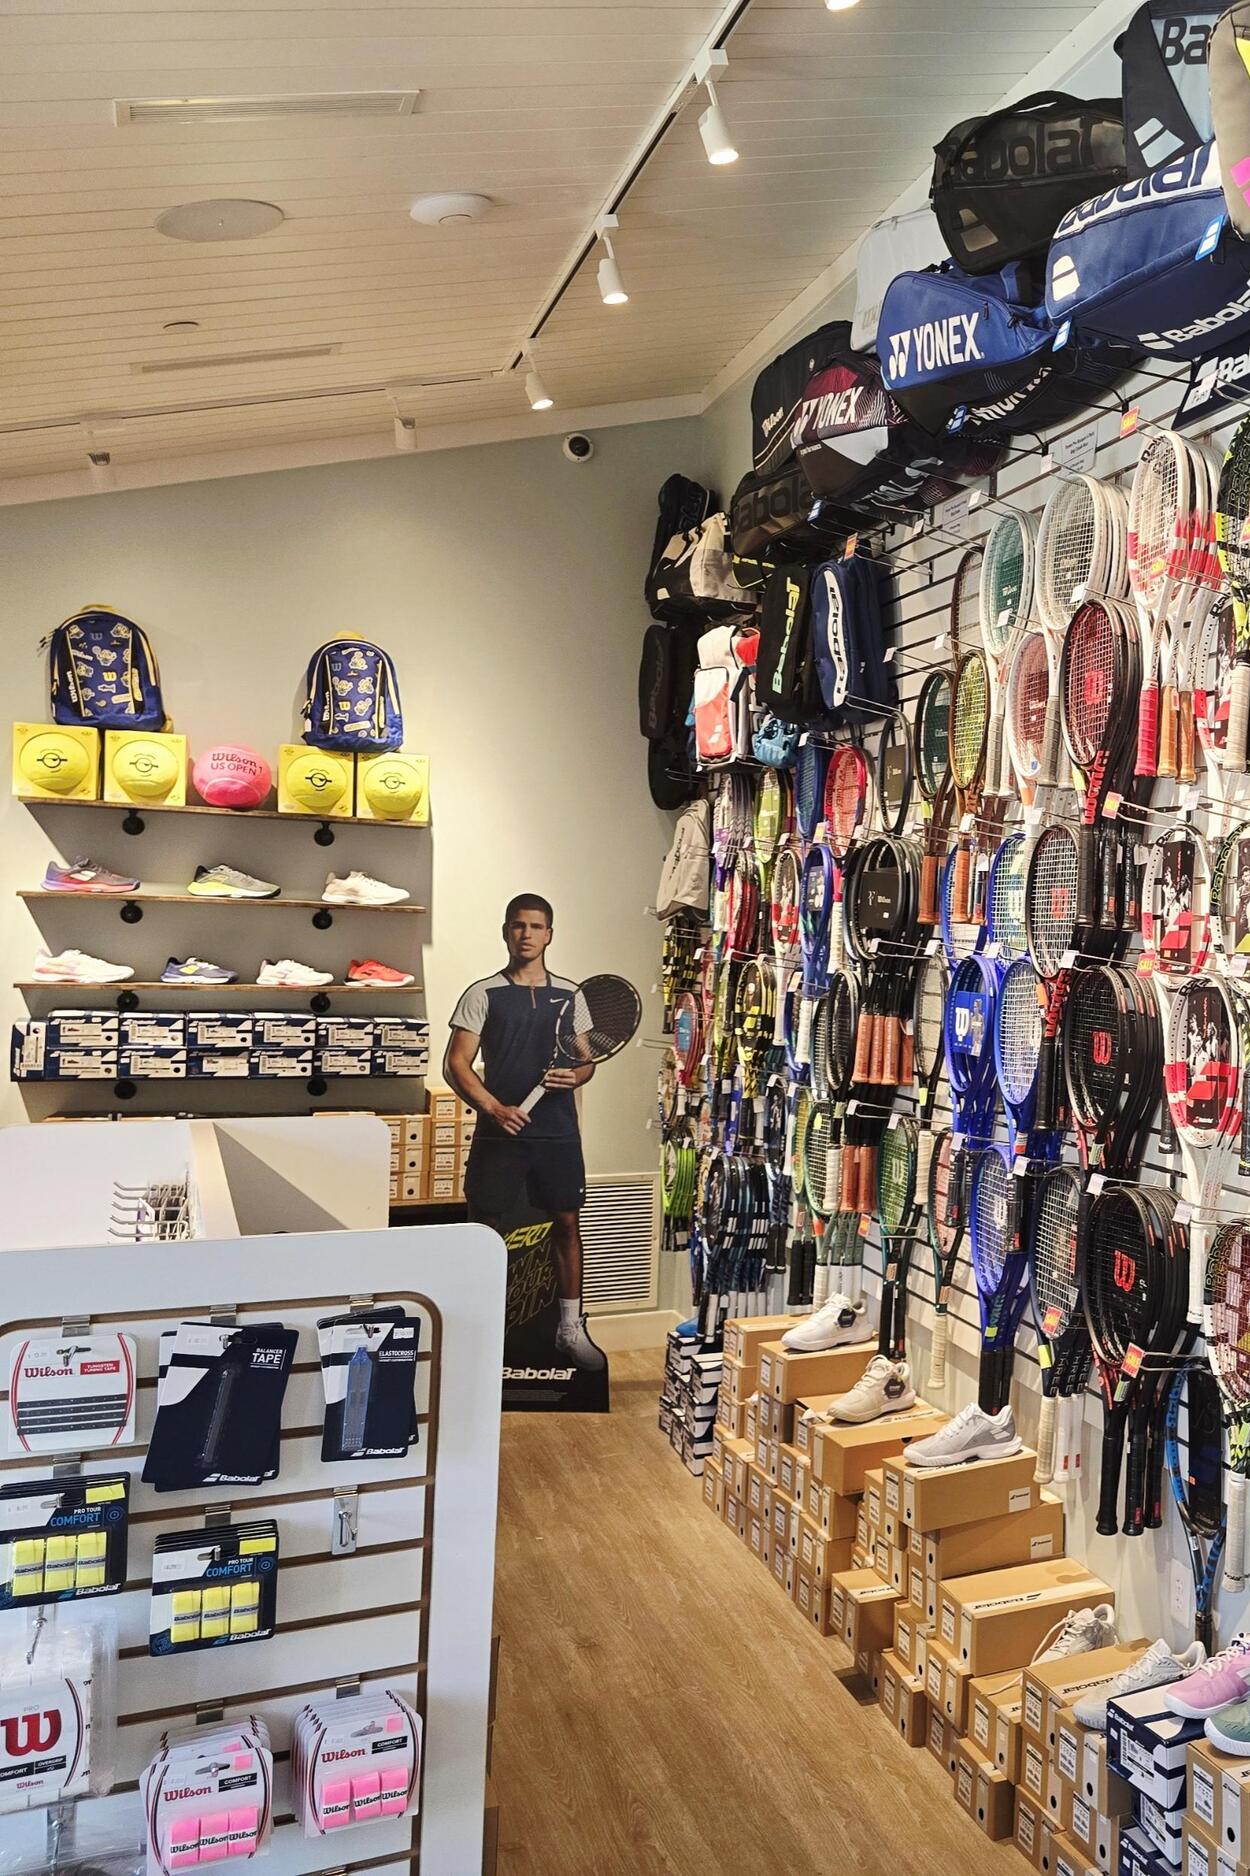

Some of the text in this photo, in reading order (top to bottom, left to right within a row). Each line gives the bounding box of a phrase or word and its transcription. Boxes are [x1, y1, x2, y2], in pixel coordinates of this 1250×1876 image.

[912, 312, 981, 372] YONEX
[813, 386, 863, 431] YONEX
[212, 753, 258, 769] Wilson
[211, 762, 257, 776] US OPEN
[252, 1353, 282, 1365] TAPE
[256, 1348, 283, 1356] BALANCER
[378, 1350, 414, 1358] ELASTOCROSS
[24, 1366, 74, 1378] Wilson
[51, 1512, 101, 1527] COMFORT
[206, 1563, 252, 1578] COMFORT
[377, 1738, 403, 1748] COMFORT
[321, 1748, 366, 1764] Wilson
[224, 1775, 252, 1785] COMFORT
[164, 1785, 212, 1802] Wilson
